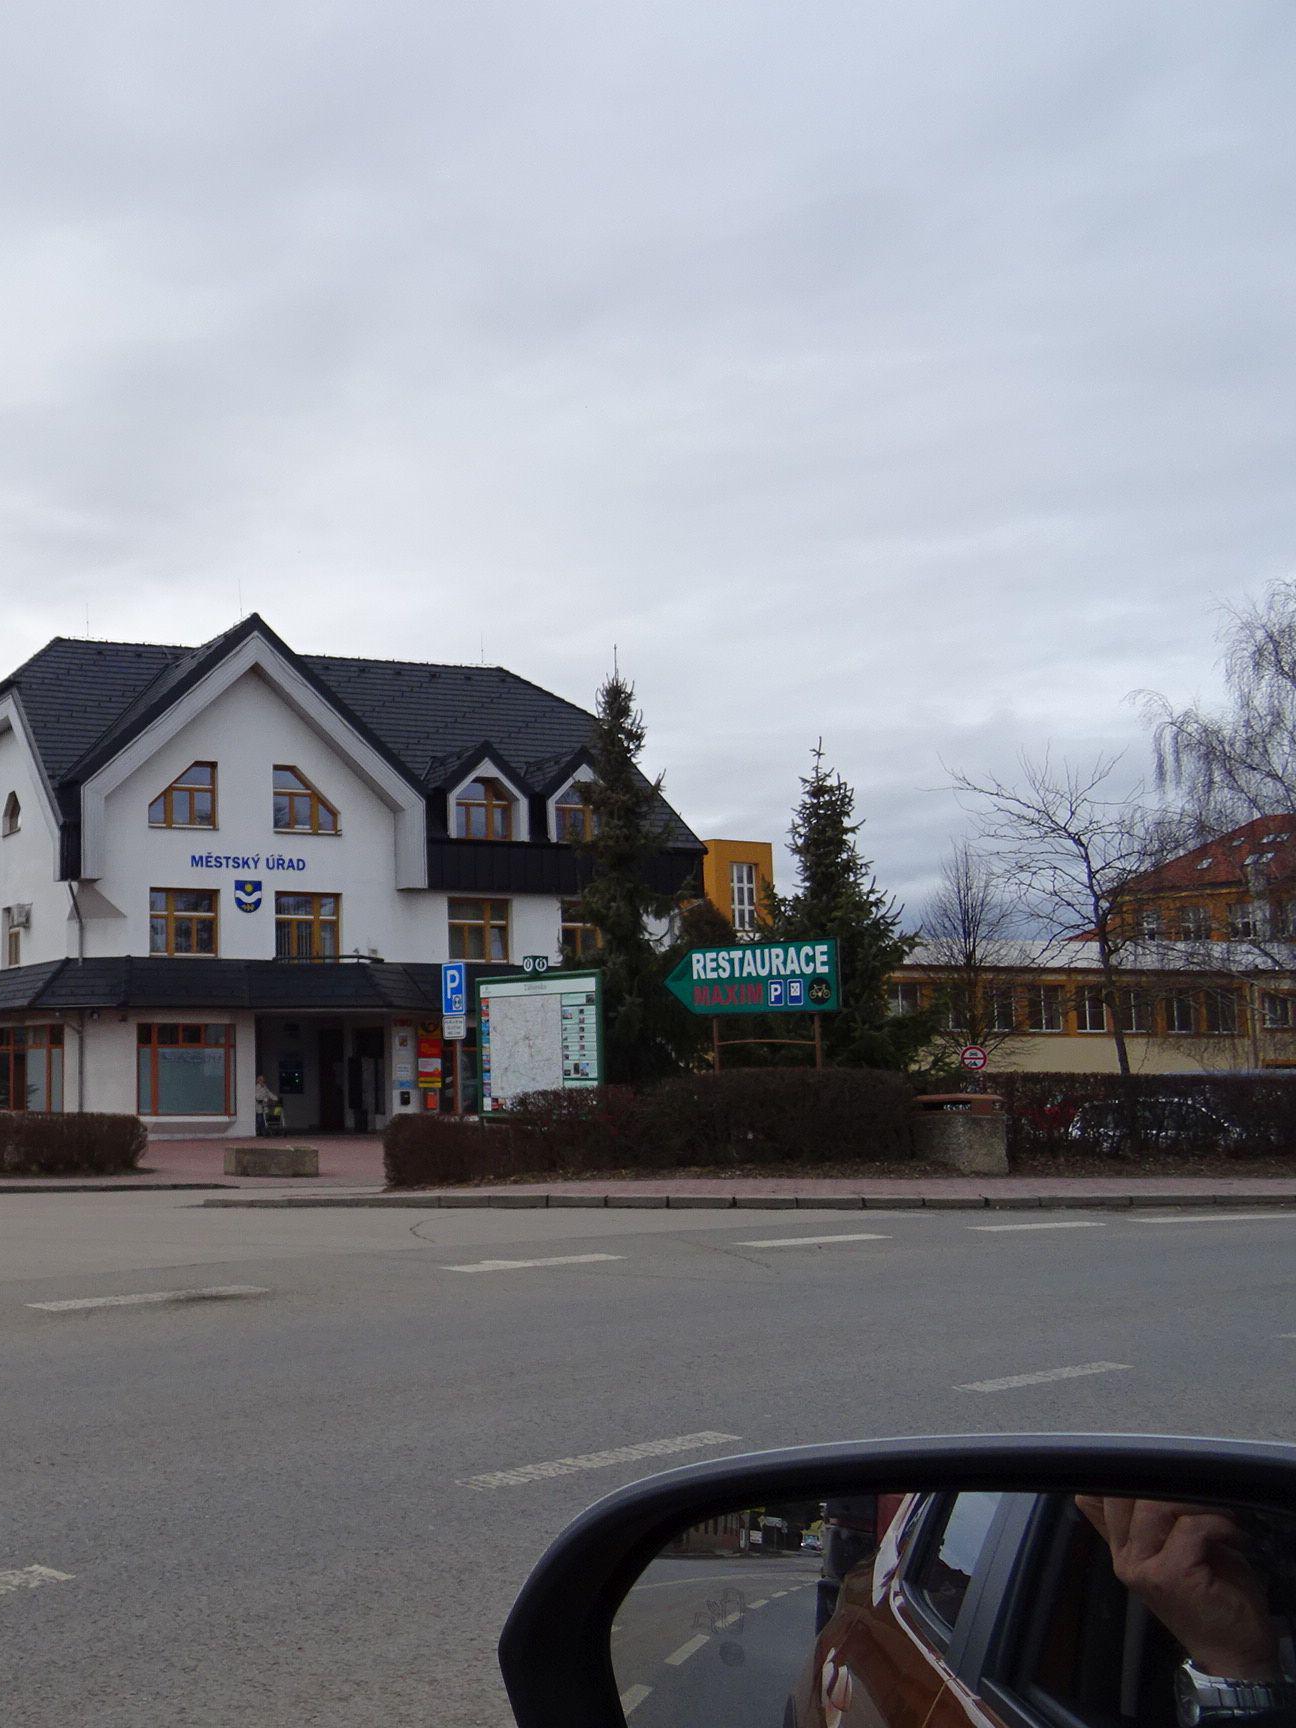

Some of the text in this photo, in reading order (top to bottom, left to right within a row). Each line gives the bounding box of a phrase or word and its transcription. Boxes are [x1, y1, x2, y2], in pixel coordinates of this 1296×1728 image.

[191, 852, 306, 871] MĚSTSKÝ ÚŘAD
[691, 945, 830, 980] RESTAURACE
[446, 969, 460, 999] P
[693, 983, 764, 1007] MAXIM
